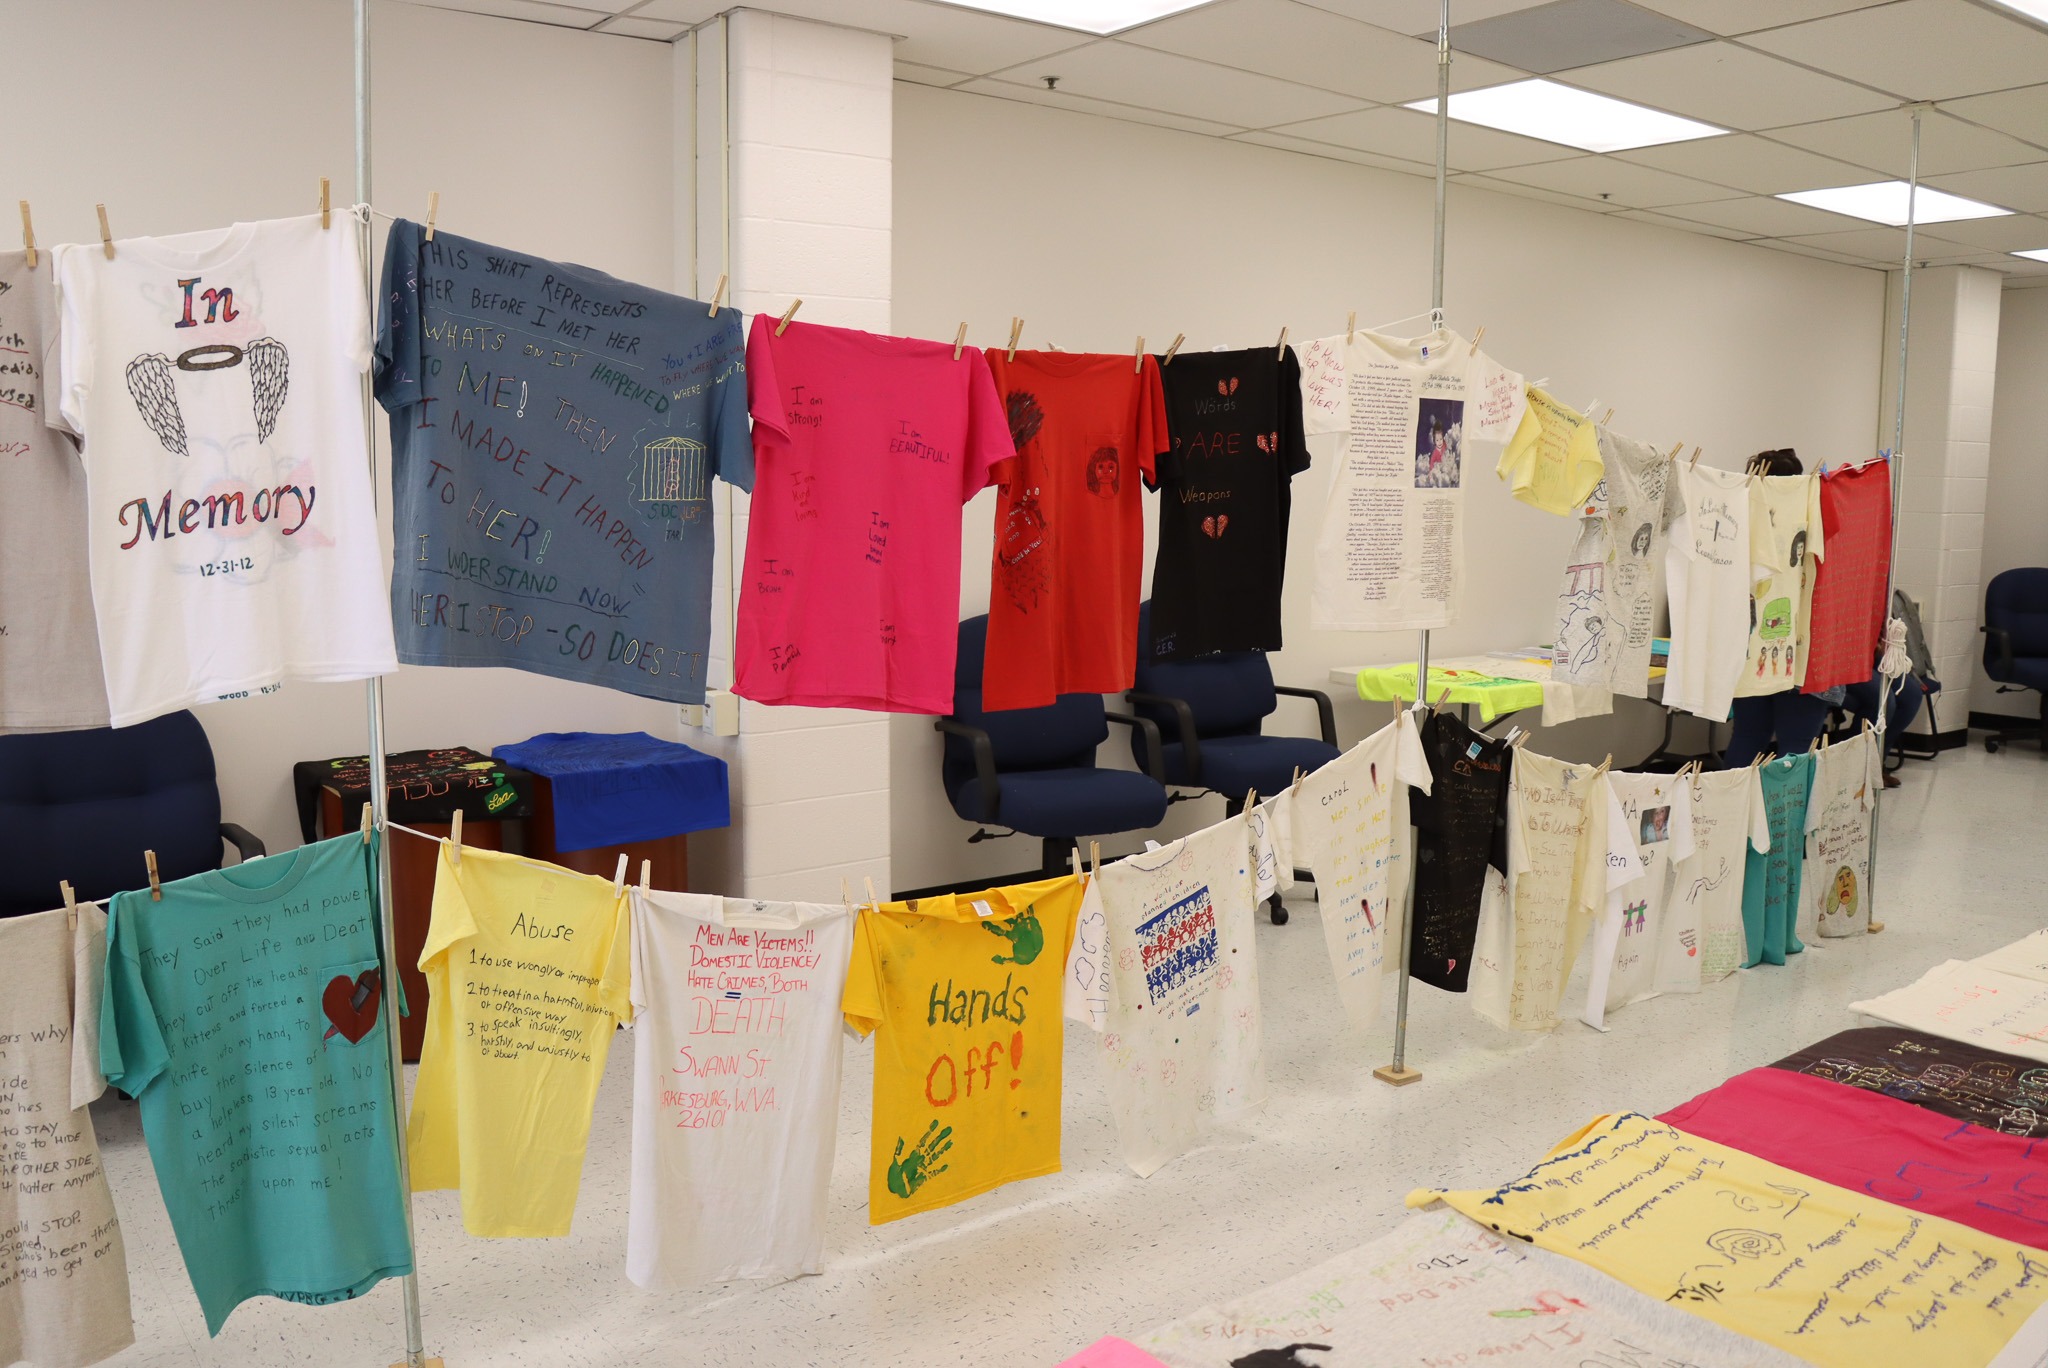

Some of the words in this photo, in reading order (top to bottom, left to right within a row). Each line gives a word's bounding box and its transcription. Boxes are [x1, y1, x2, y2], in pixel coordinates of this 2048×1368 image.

[418, 241, 469, 270] THIS
[542, 273, 648, 319] REPRESENTS
[174, 276, 240, 329] In
[421, 277, 453, 303] HER
[472, 287, 524, 316] BEFORE
[531, 305, 555, 328] I
[558, 320, 596, 342] MET
[607, 331, 640, 356] HER
[423, 315, 506, 351] WHATS
[548, 351, 584, 368] IT
[590, 362, 670, 415] HAPPENED
[420, 355, 442, 377] TO
[457, 362, 529, 419] ME!
[555, 397, 618, 453] THEN
[791, 386, 805, 405] I
[809, 396, 823, 405] am
[1194, 400, 1237, 415] Words
[1309, 395, 1340, 415] HER!
[898, 420, 910, 436] I
[910, 430, 921, 439] am
[890, 439, 950, 465] BEAUTIFUL!
[1186, 431, 1241, 459] ARE
[417, 397, 437, 429] I
[452, 410, 530, 476] MADE
[532, 462, 582, 503] IT
[574, 494, 654, 571] HAPPEN
[1179, 487, 1231, 504] Weapons
[118, 486, 316, 551] Memory
[427, 459, 456, 504] TO
[467, 488, 552, 565] HER!
[871, 511, 879, 526] I
[879, 519, 890, 529] am
[199, 556, 255, 578] 12-31-12
[417, 534, 429, 562] I
[579, 586, 632, 615] NOW
[763, 559, 778, 575] I
[781, 568, 794, 577] am
[474, 605, 535, 647] STOP
[608, 630, 664, 675] DOES
[669, 652, 702, 680] IT
[488, 791, 514, 810] Lea
[140, 947, 179, 970] They
[193, 929, 223, 950] Said
[232, 912, 272, 934] they
[283, 901, 310, 919] had
[511, 912, 575, 942] Abuse
[194, 961, 227, 986] Over
[241, 938, 282, 964] Life
[479, 952, 492, 967] to
[496, 957, 513, 969] use
[196, 997, 215, 1017] cut
[221, 983, 240, 1004] off
[246, 977, 264, 989] the
[271, 965, 309, 986] heads
[251, 995, 287, 1014] forced
[479, 982, 490, 996] to
[493, 983, 522, 1000] treat
[927, 971, 1028, 1031] Hands
[480, 1023, 489, 1033] to
[494, 1016, 522, 1035] speak
[495, 1000, 541, 1019] offensive
[545, 1011, 567, 1025] way
[689, 996, 785, 1037] DEATH
[31, 1023, 69, 1043] why
[170, 1062, 209, 1089] Knife
[258, 1025, 291, 1042] hand,
[295, 1018, 311, 1031] to
[516, 1040, 535, 1051] and
[538, 1044, 579, 1062] unjustly
[581, 1052, 591, 1063] to
[925, 1031, 1023, 1107] Off!
[180, 1096, 213, 1118] buy
[216, 1073, 236, 1093] the
[192, 1129, 203, 1140] a
[265, 1085, 277, 1099] 13
[284, 1085, 312, 1102] year
[351, 1064, 373, 1082] No
[25, 1122, 58, 1137] STAY
[677, 1109, 726, 1129] 26101
[31, 1138, 47, 1149] to
[54, 1132, 82, 1144] HIDE
[197, 1135, 234, 1167] heard
[201, 1171, 225, 1193] the
[288, 1135, 333, 1158] sexual
[343, 1126, 375, 1144] acts
[262, 1175, 295, 1194] upon
[43, 1266, 57, 1277] to
[64, 1257, 82, 1278] get
[94, 1242, 112, 1259] out
[50, 1241, 87, 1259] been
